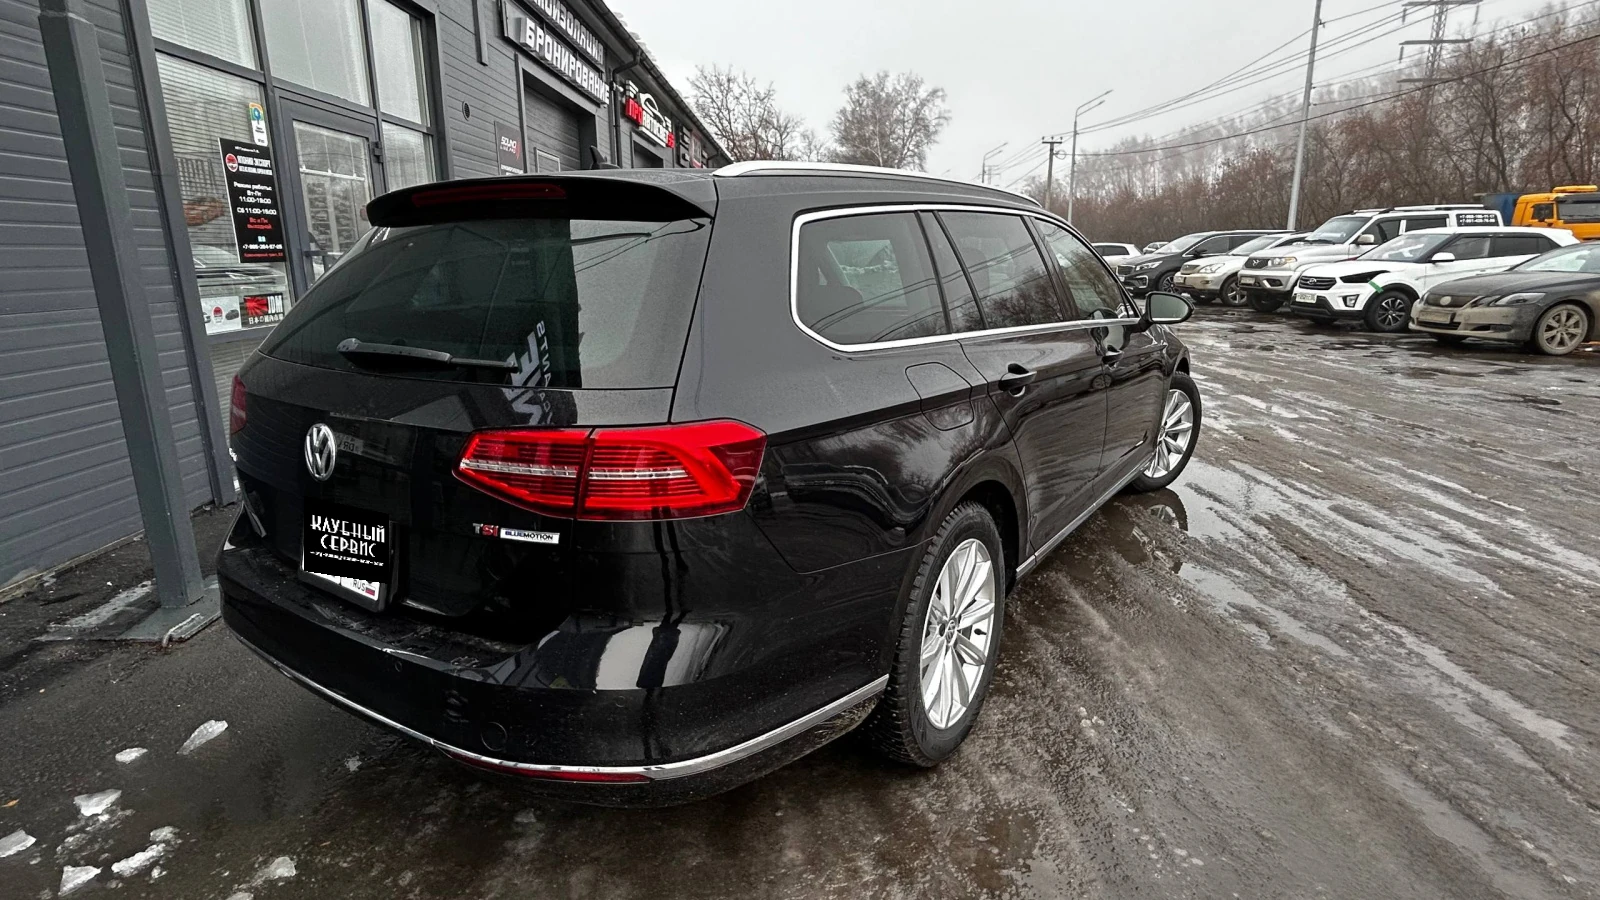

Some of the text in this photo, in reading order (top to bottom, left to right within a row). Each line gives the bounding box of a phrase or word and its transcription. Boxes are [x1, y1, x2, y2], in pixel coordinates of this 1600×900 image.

[533, 0, 604, 64] ОИЗОЛЯЦИЯ
[525, 17, 609, 104] БРОНИРОВАНИЕ
[267, 295, 283, 314] JDM
[505, 530, 554, 541] BLUEMOTION
[352, 579, 366, 592] RUS
